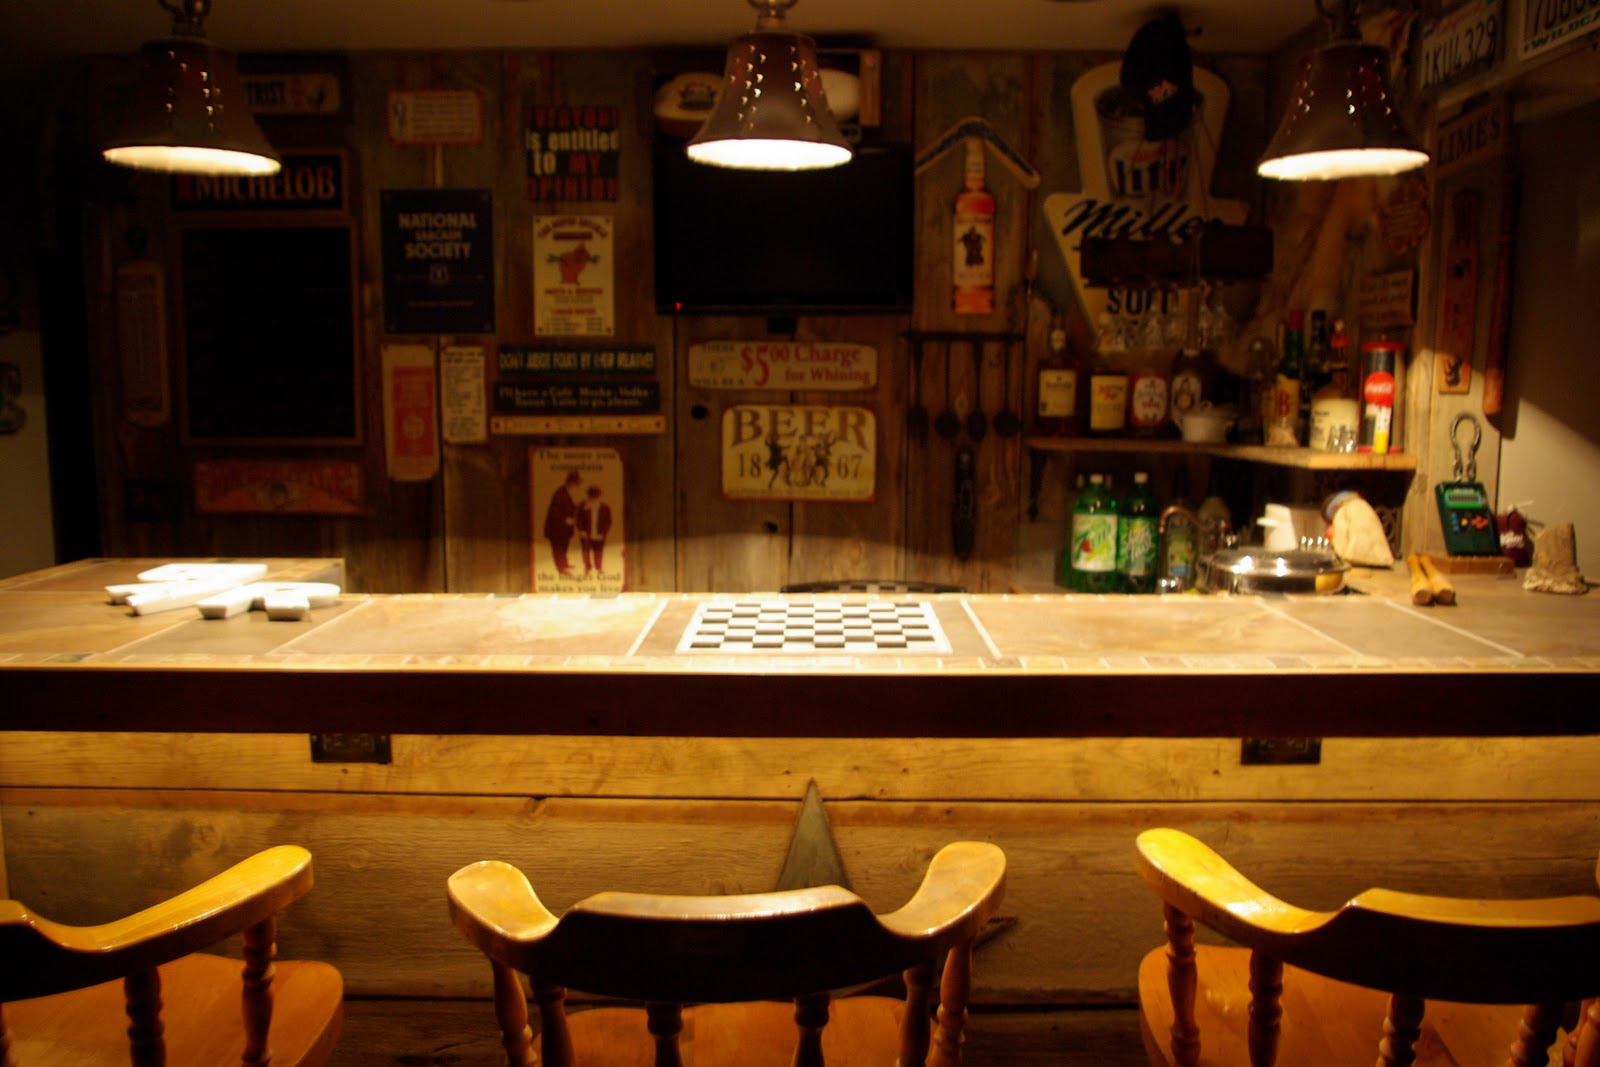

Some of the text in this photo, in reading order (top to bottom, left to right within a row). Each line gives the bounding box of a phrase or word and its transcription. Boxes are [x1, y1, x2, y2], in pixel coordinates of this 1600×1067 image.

[547, 127, 618, 151] entitled
[196, 163, 336, 201] MICHELOB
[398, 211, 478, 230] NATIONAL
[1063, 199, 1223, 241] Miller
[403, 241, 472, 260] SOCIETY
[794, 340, 862, 367] Charge
[785, 367, 871, 385] for Whining
[731, 409, 868, 451] BEER
[539, 450, 559, 460] The
[563, 452, 593, 460] more
[738, 453, 762, 478] 18
[837, 454, 863, 480] 67
